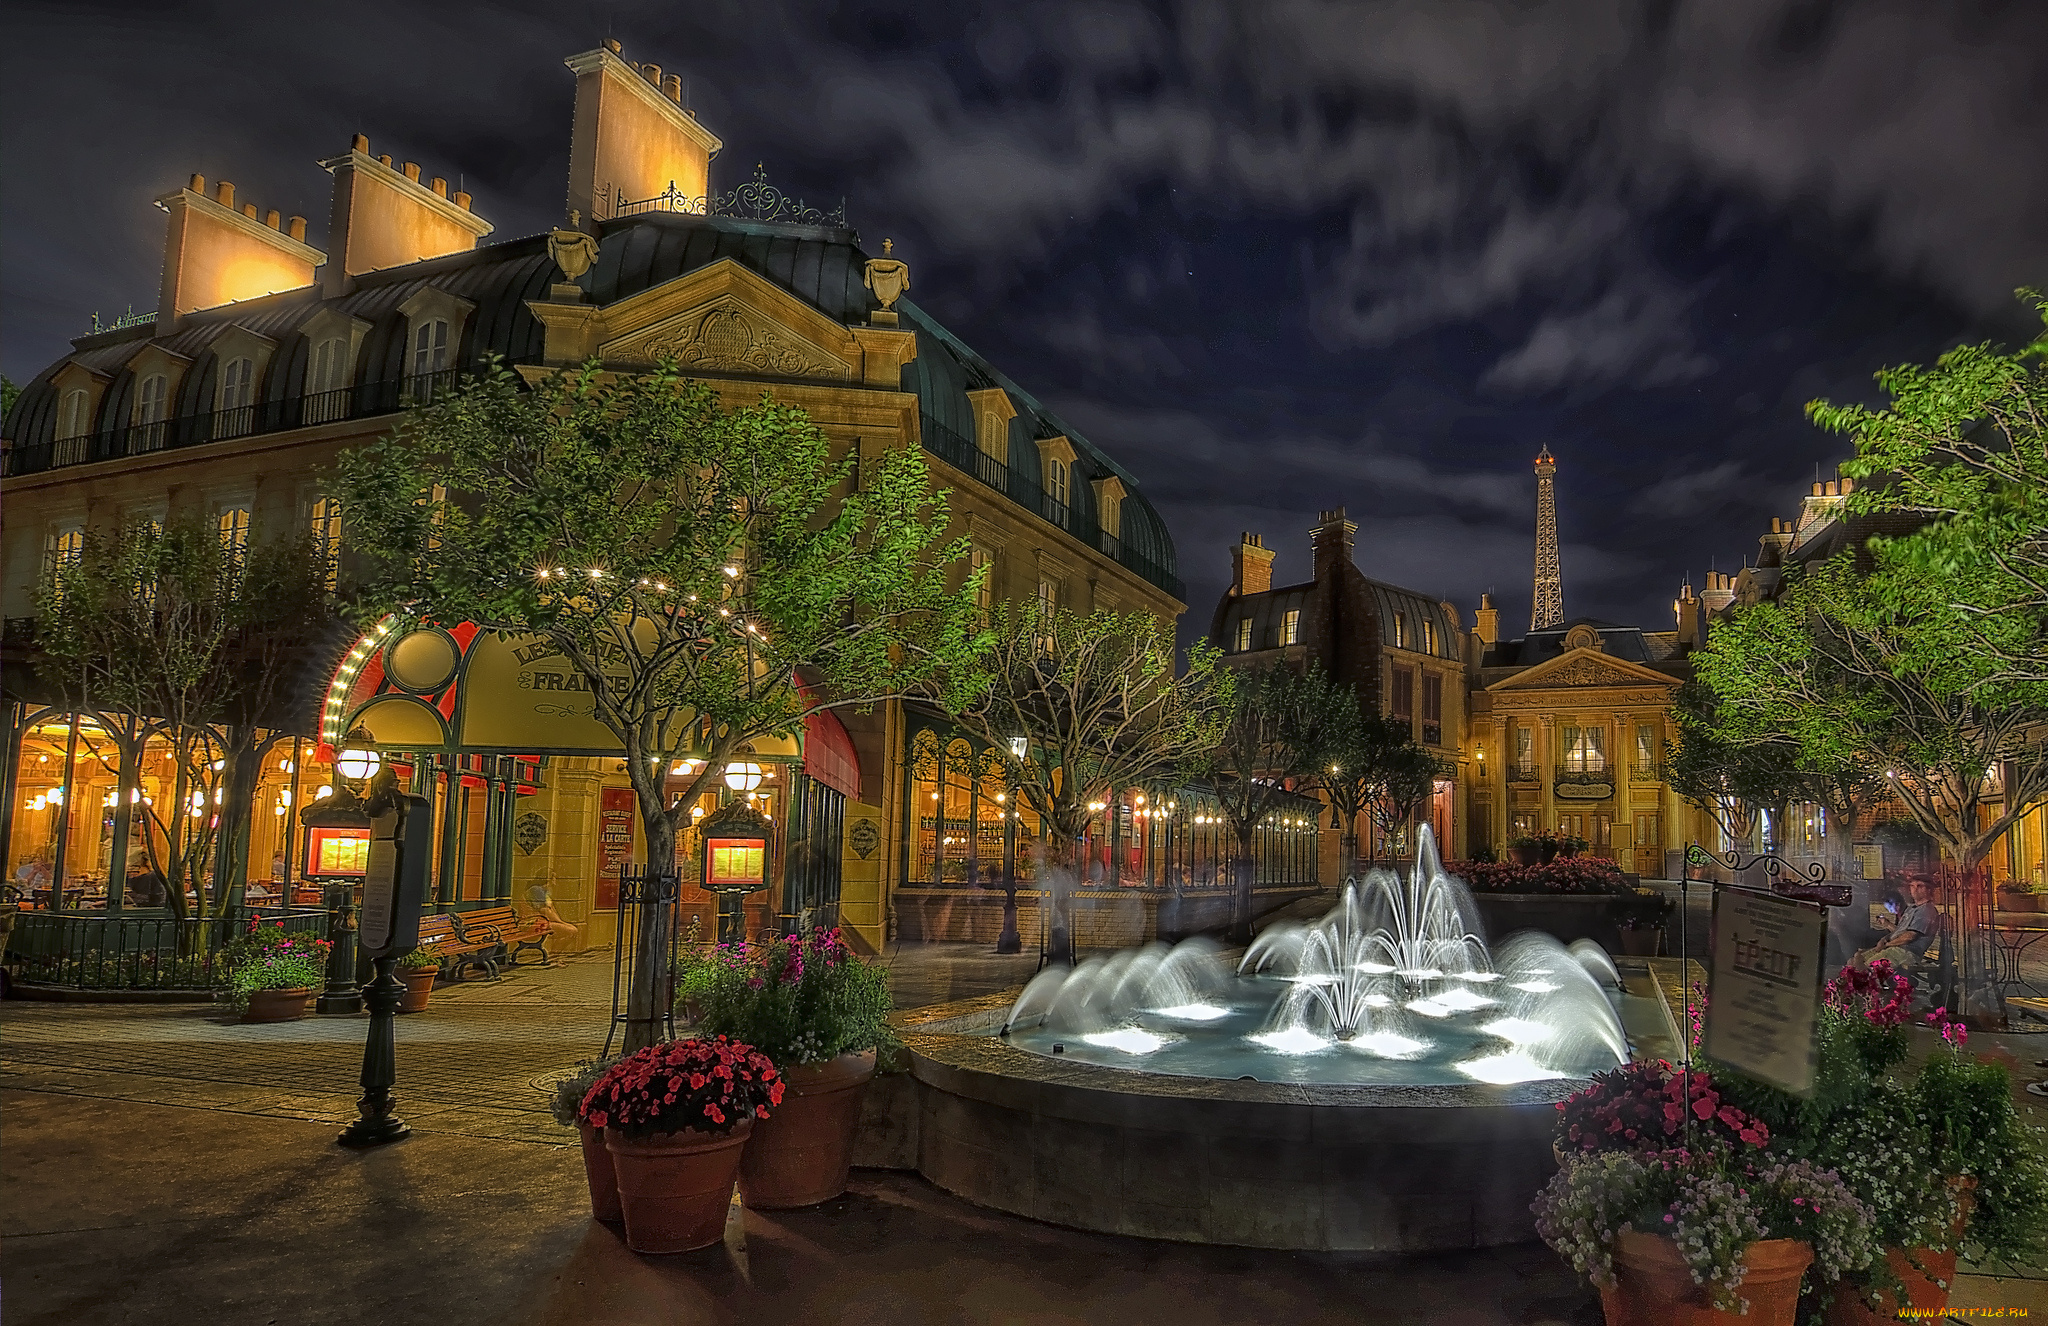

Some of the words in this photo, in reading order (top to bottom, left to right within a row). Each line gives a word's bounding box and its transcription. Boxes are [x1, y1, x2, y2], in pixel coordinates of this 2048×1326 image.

[511, 640, 553, 667] LE
[606, 824, 627, 834] SERVICE
[614, 834, 631, 843] CARTE
